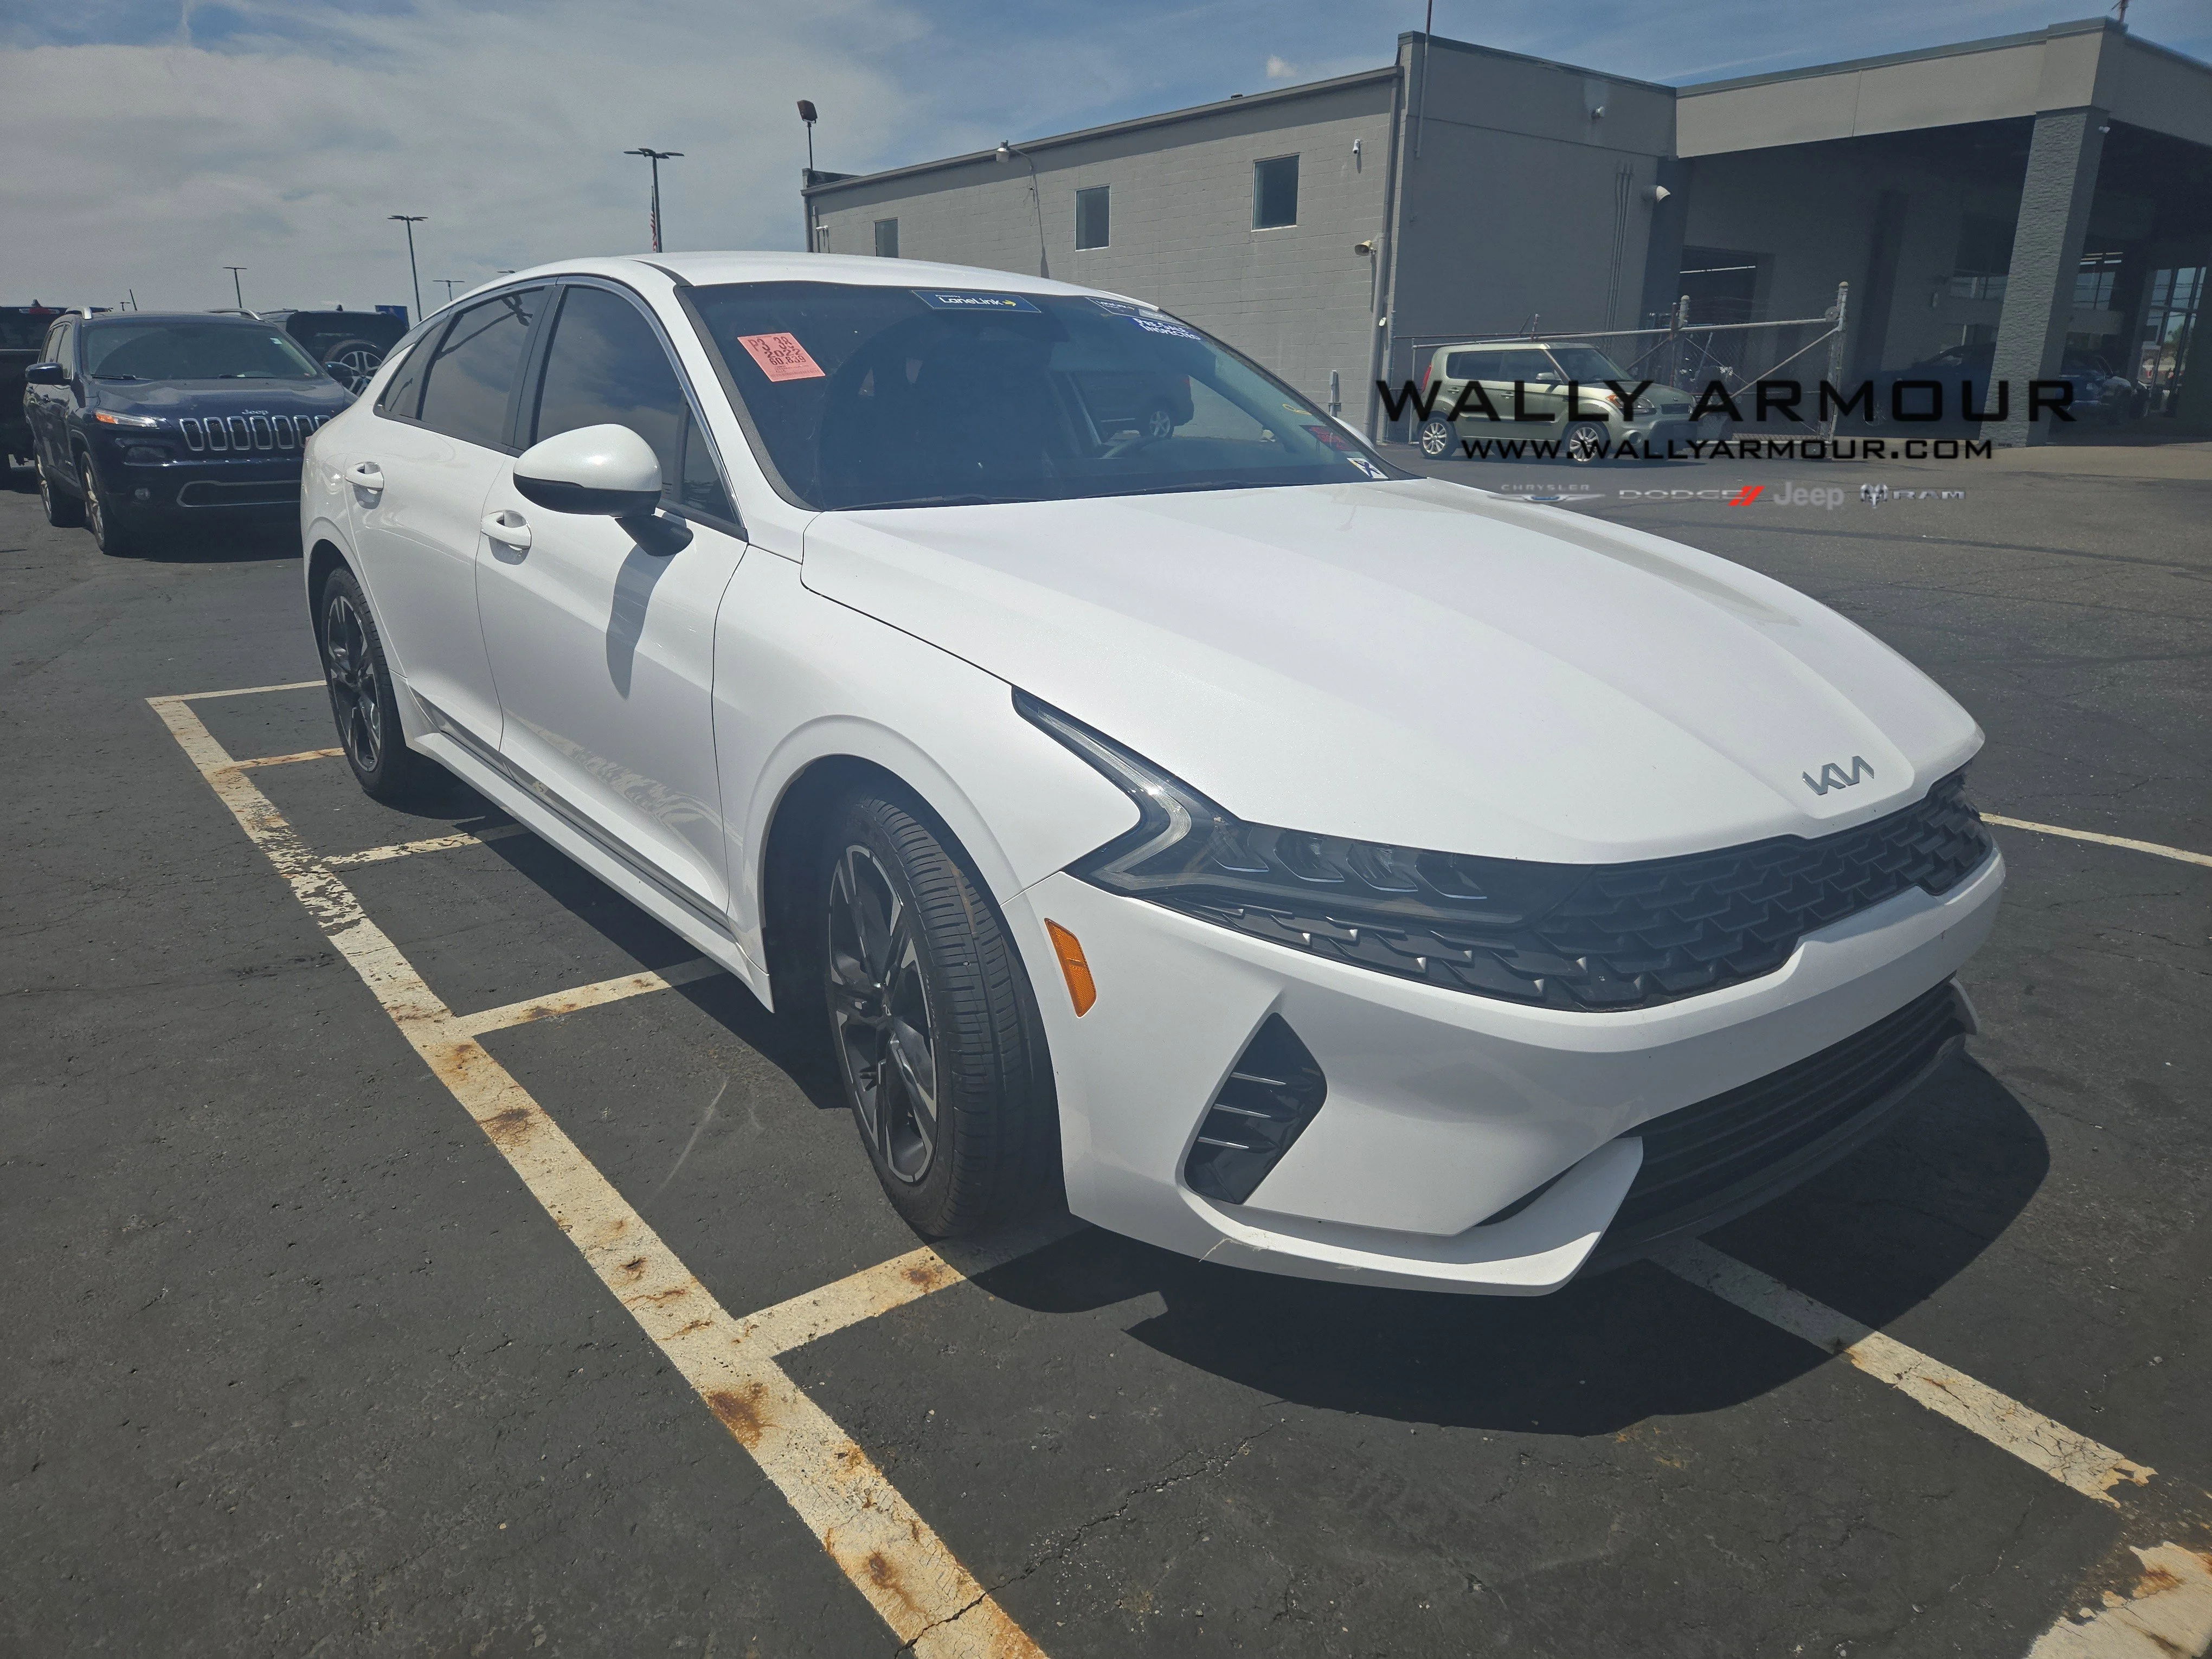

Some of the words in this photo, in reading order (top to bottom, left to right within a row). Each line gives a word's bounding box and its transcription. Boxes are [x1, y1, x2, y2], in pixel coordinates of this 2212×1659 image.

[938, 297, 1004, 305] LaneLink
[748, 338, 771, 352] P3
[764, 348, 803, 358] 2022
[1802, 755, 1874, 796] KIA
